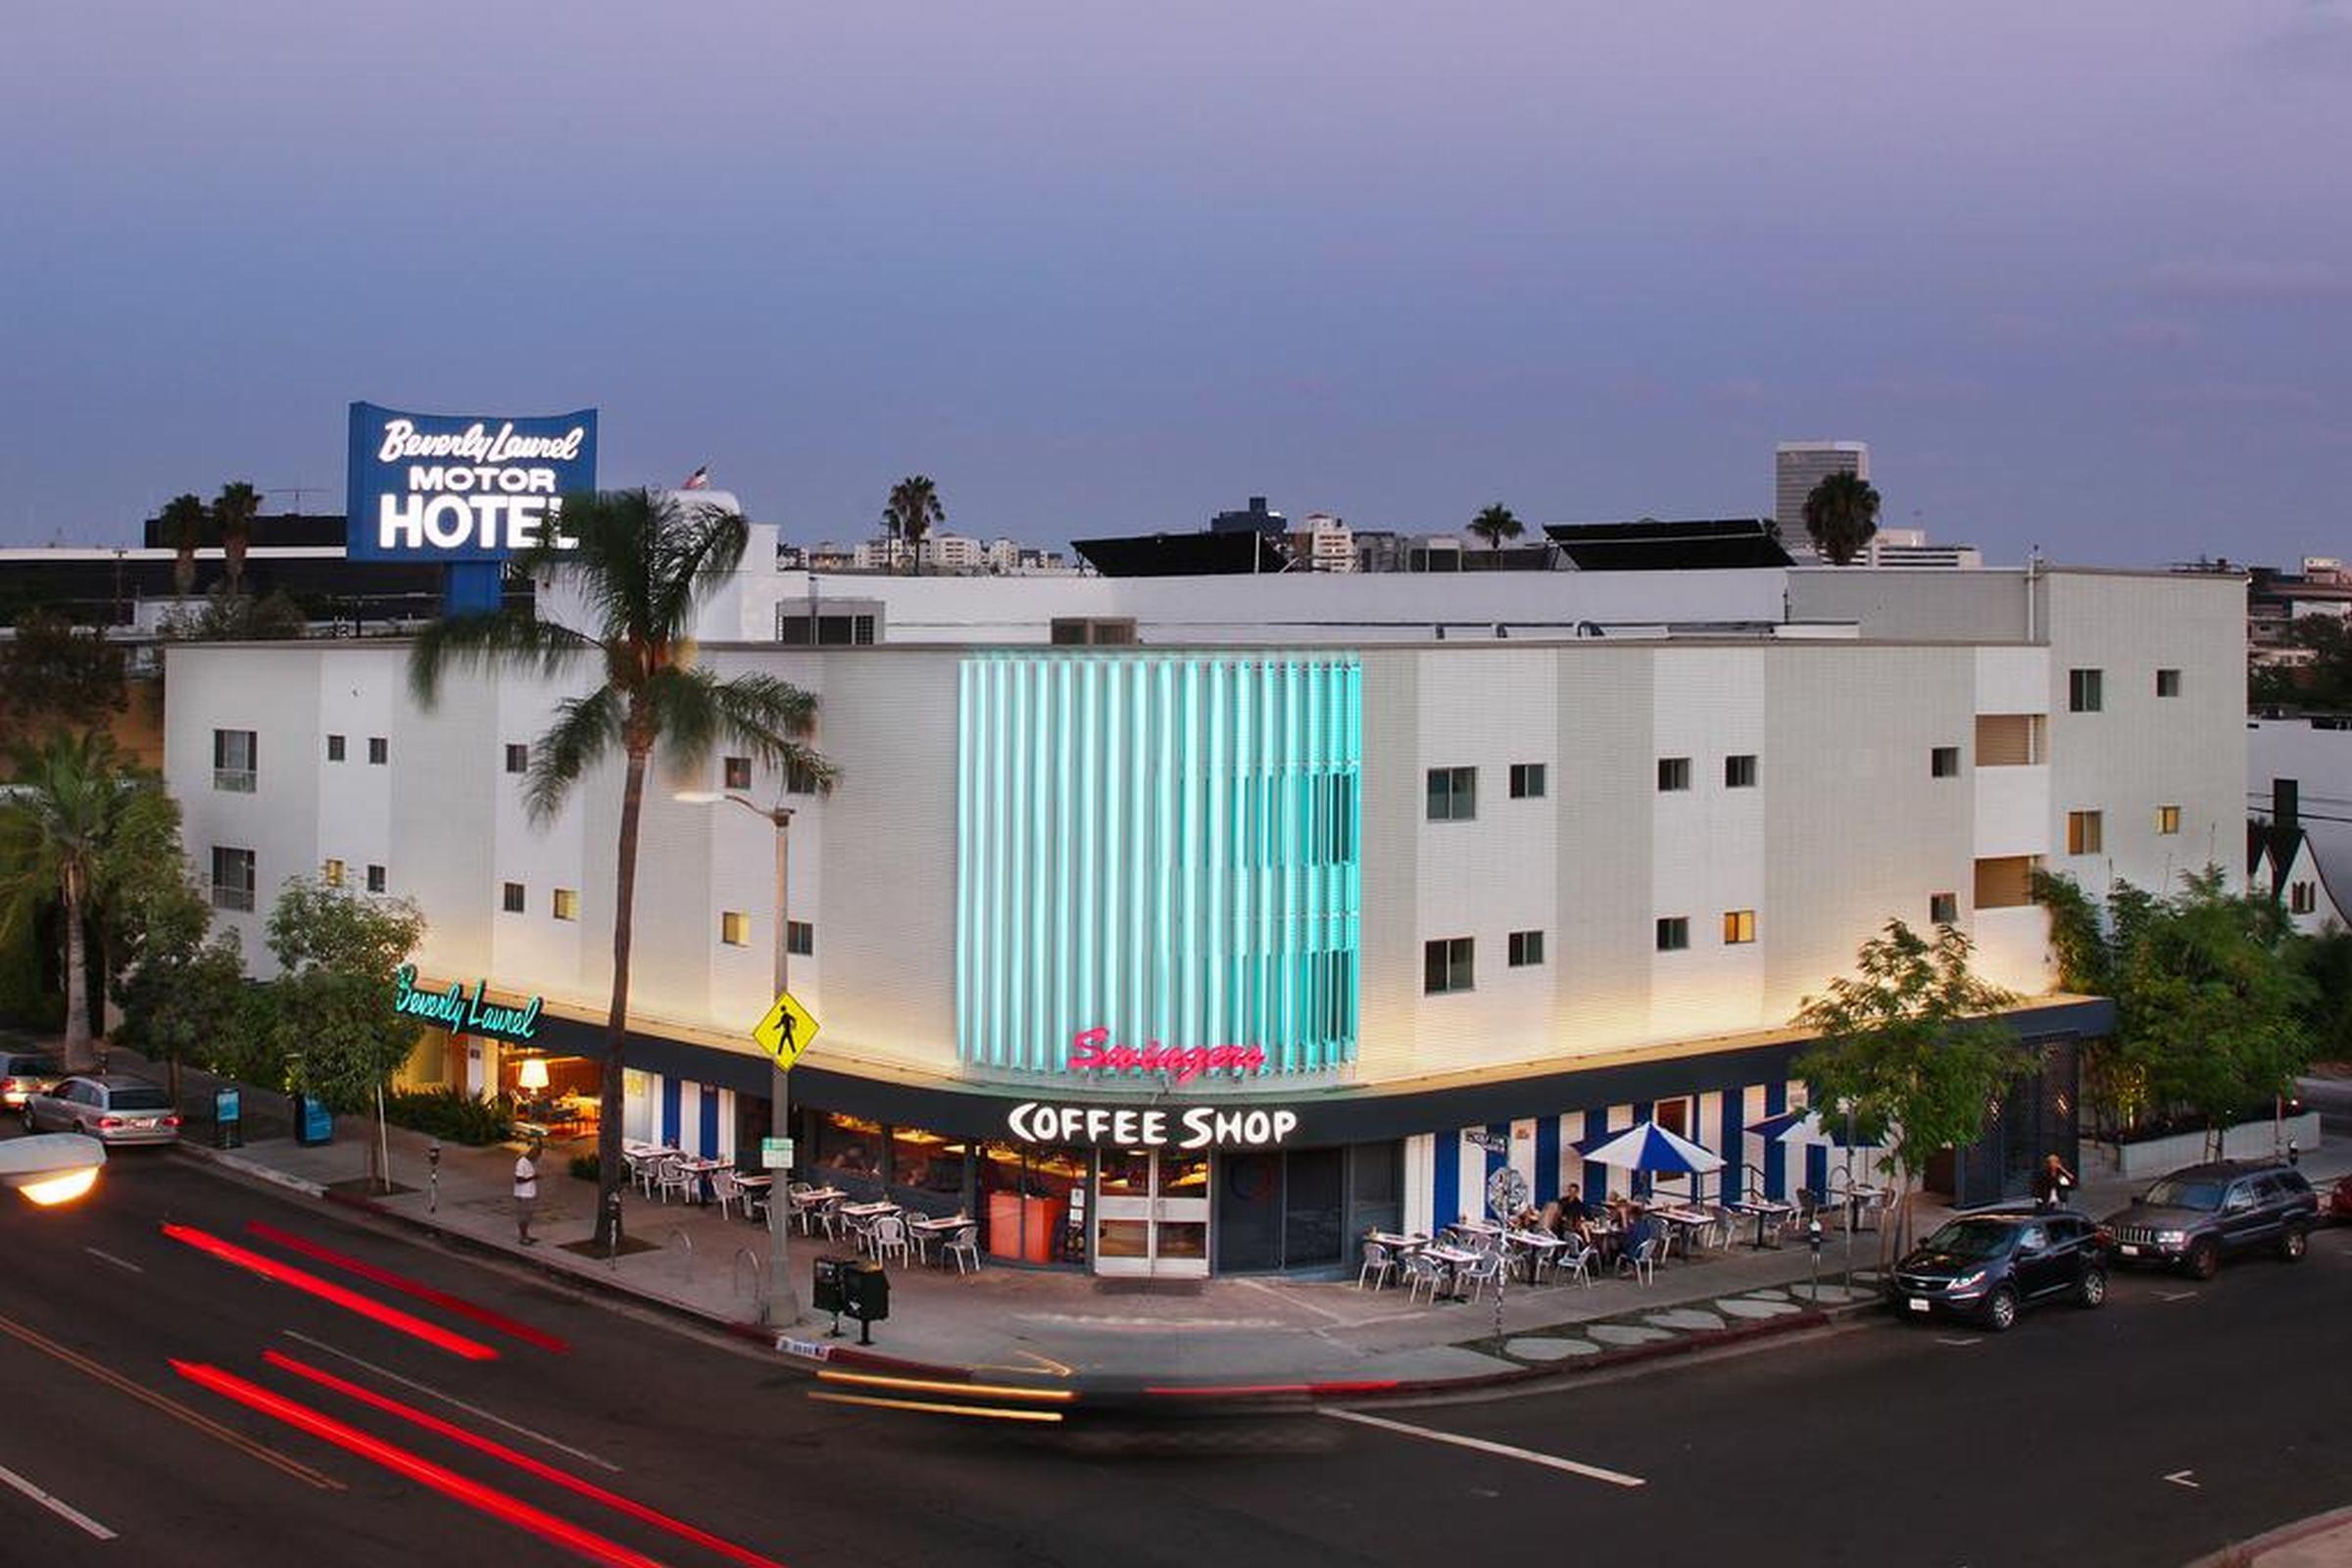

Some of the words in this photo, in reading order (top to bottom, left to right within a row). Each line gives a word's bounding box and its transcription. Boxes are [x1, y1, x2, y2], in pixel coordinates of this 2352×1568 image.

[378, 419, 493, 464] Beverly
[488, 421, 584, 463] Laurel
[409, 466, 557, 493] MOTOR
[379, 493, 579, 549] HOTEL
[396, 963, 466, 1035] Beverly
[467, 979, 541, 1039] Laurel
[1067, 1027, 1266, 1085] Swingers
[1007, 1102, 1168, 1145] COFFEE
[1178, 1107, 1298, 1149] SHOP
